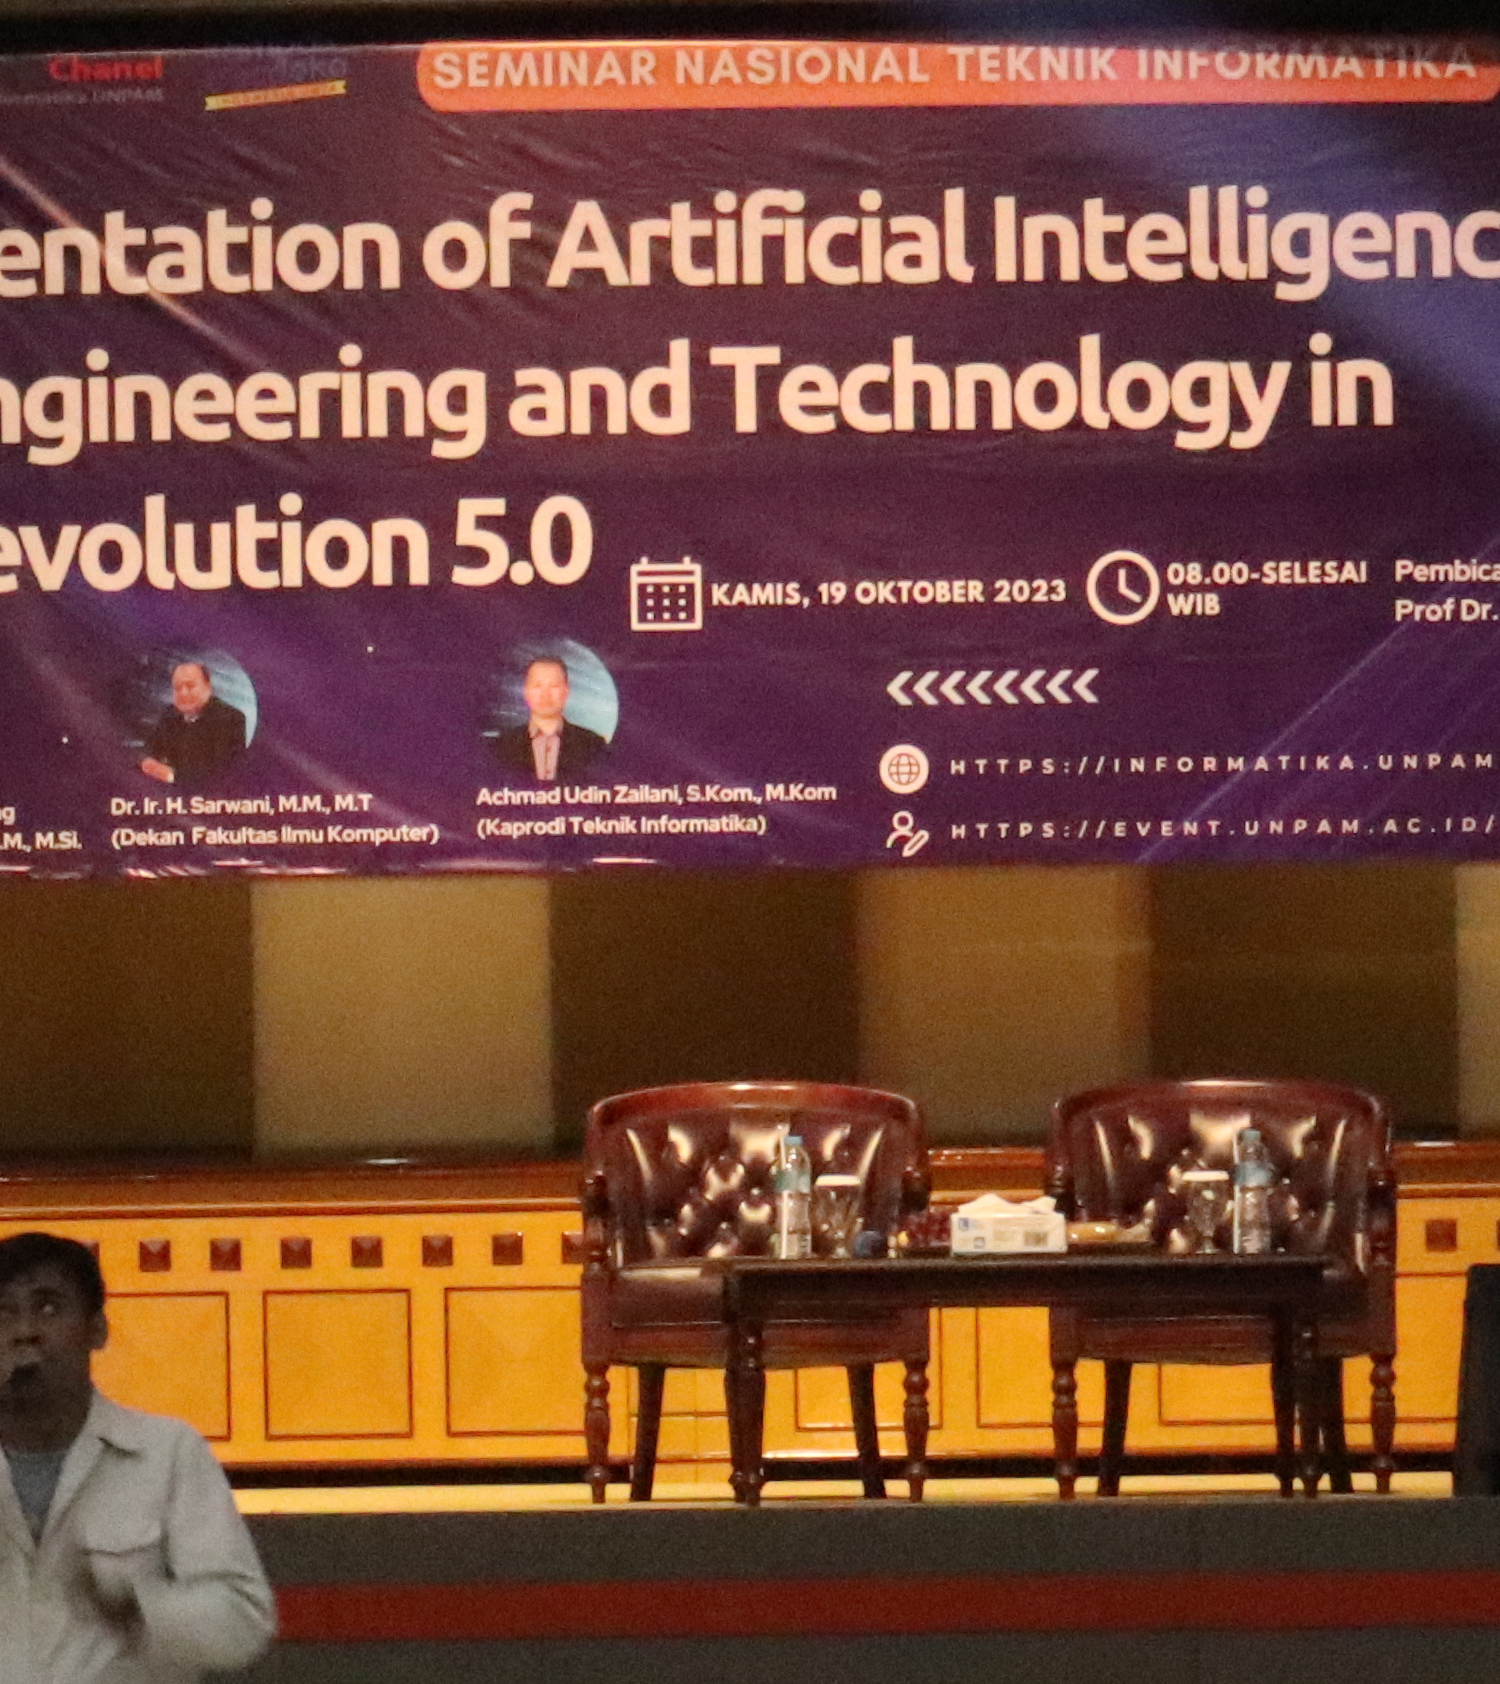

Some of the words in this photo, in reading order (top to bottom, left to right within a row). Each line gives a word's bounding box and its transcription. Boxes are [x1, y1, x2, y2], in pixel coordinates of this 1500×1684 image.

[48, 54, 164, 82] Chanel
[432, 49, 658, 89] SEMINAR
[675, 46, 931, 85] NASIONAL
[947, 45, 1118, 82] TEKNIK
[1137, 42, 1479, 81] INFORMATIKA
[421, 191, 534, 290] of
[546, 186, 975, 289] Artificial
[508, 338, 692, 437] and
[708, 333, 1293, 451] Technology
[1308, 331, 1395, 427] in
[450, 495, 594, 587] 5.0
[1166, 560, 1369, 586] 08.00-SELESAI
[711, 581, 811, 609] KAMIS,
[817, 582, 847, 605] 19
[854, 580, 986, 604] OKTOBER
[993, 578, 1068, 602] 2023
[1167, 593, 1221, 617] WIB
[1394, 597, 1456, 622] Prof
[1459, 598, 1499, 622] Dr.
[110, 797, 140, 816] Dr.
[143, 797, 163, 815] Ir.
[165, 797, 188, 815] H.
[190, 795, 276, 815] Sarwani,
[278, 795, 331, 815] M.M.,
[334, 793, 374, 813] M.T
[476, 788, 561, 806] Achmad
[564, 786, 611, 804] Udin
[614, 785, 683, 806] Zailani,
[686, 784, 763, 804] S.Kom.,
[765, 783, 838, 802] M.Kom
[110, 828, 185, 850] (Dekan
[192, 826, 278, 846] Fakultas
[280, 825, 325, 845] Ilmu
[327, 823, 440, 847] Komputer)
[476, 816, 566, 839] (Kaprodi
[568, 815, 638, 835] Teknik
[640, 814, 768, 837] Informatika)
[34, 831, 83, 850] M.Si.
